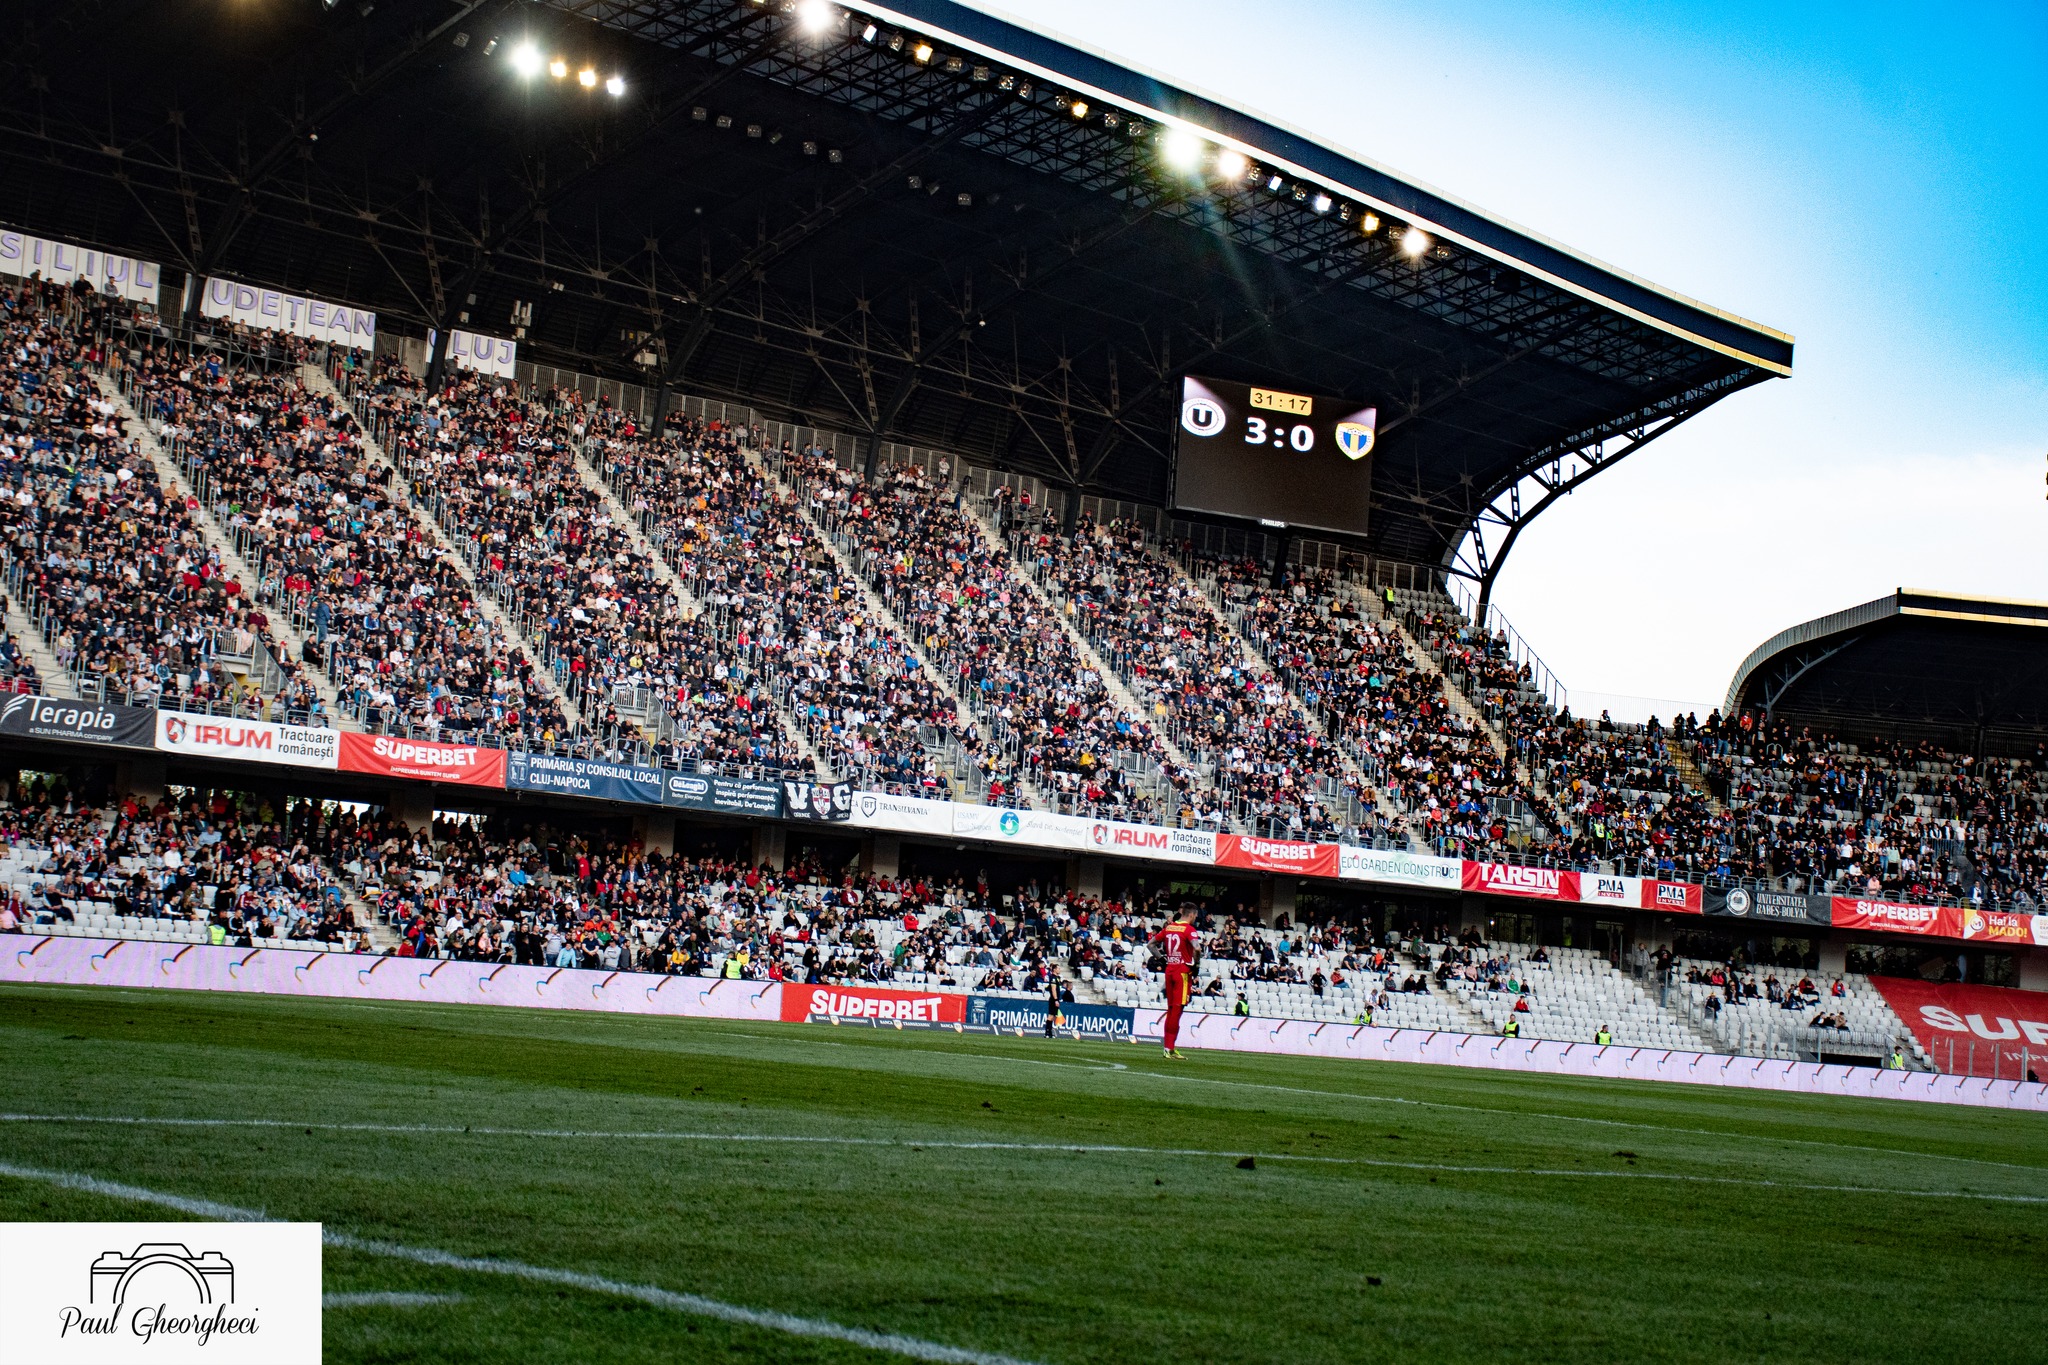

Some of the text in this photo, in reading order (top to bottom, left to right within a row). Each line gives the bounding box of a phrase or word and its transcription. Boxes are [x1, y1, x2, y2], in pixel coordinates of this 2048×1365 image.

[1192, 408, 1212, 427] U
[1245, 417, 1314, 451] 3:0
[26, 695, 116, 731] Terapia
[35, 727, 51, 735] SUN
[52, 728, 83, 738] PHARMA
[195, 725, 272, 750] IRUM
[280, 727, 334, 745] Tractoare
[372, 737, 477, 766] SUPERBET
[530, 756, 575, 773] PRIMĂRIA
[587, 764, 632, 780] CONSILIUL
[634, 770, 662, 785] LOCAL
[530, 773, 591, 790] CLUJ-NAPOCA
[713, 779, 733, 788] Pentru
[864, 801, 873, 809] BT
[879, 802, 928, 816] TRANSILVANIA
[1114, 829, 1168, 849] IRUM
[1173, 830, 1212, 846] Tractoare
[1240, 836, 1317, 860] SUPERBET
[1341, 856, 1360, 869] ECO
[1361, 858, 1400, 874] GARDEN
[1403, 861, 1461, 880] CONSTRUCT
[1479, 862, 1560, 889] TARSIN
[1598, 879, 1624, 893] PMA
[1658, 885, 1684, 900] PMA
[1756, 892, 1807, 908] UNIVERSITATEA
[1856, 900, 1939, 921] SUPERBET
[1989, 914, 2007, 926] Hai
[1989, 926, 2028, 938] MADO!
[1166, 933, 1181, 956] 12
[809, 989, 942, 1022] SUPERBET
[990, 1007, 1048, 1029] PRIMĂRIA
